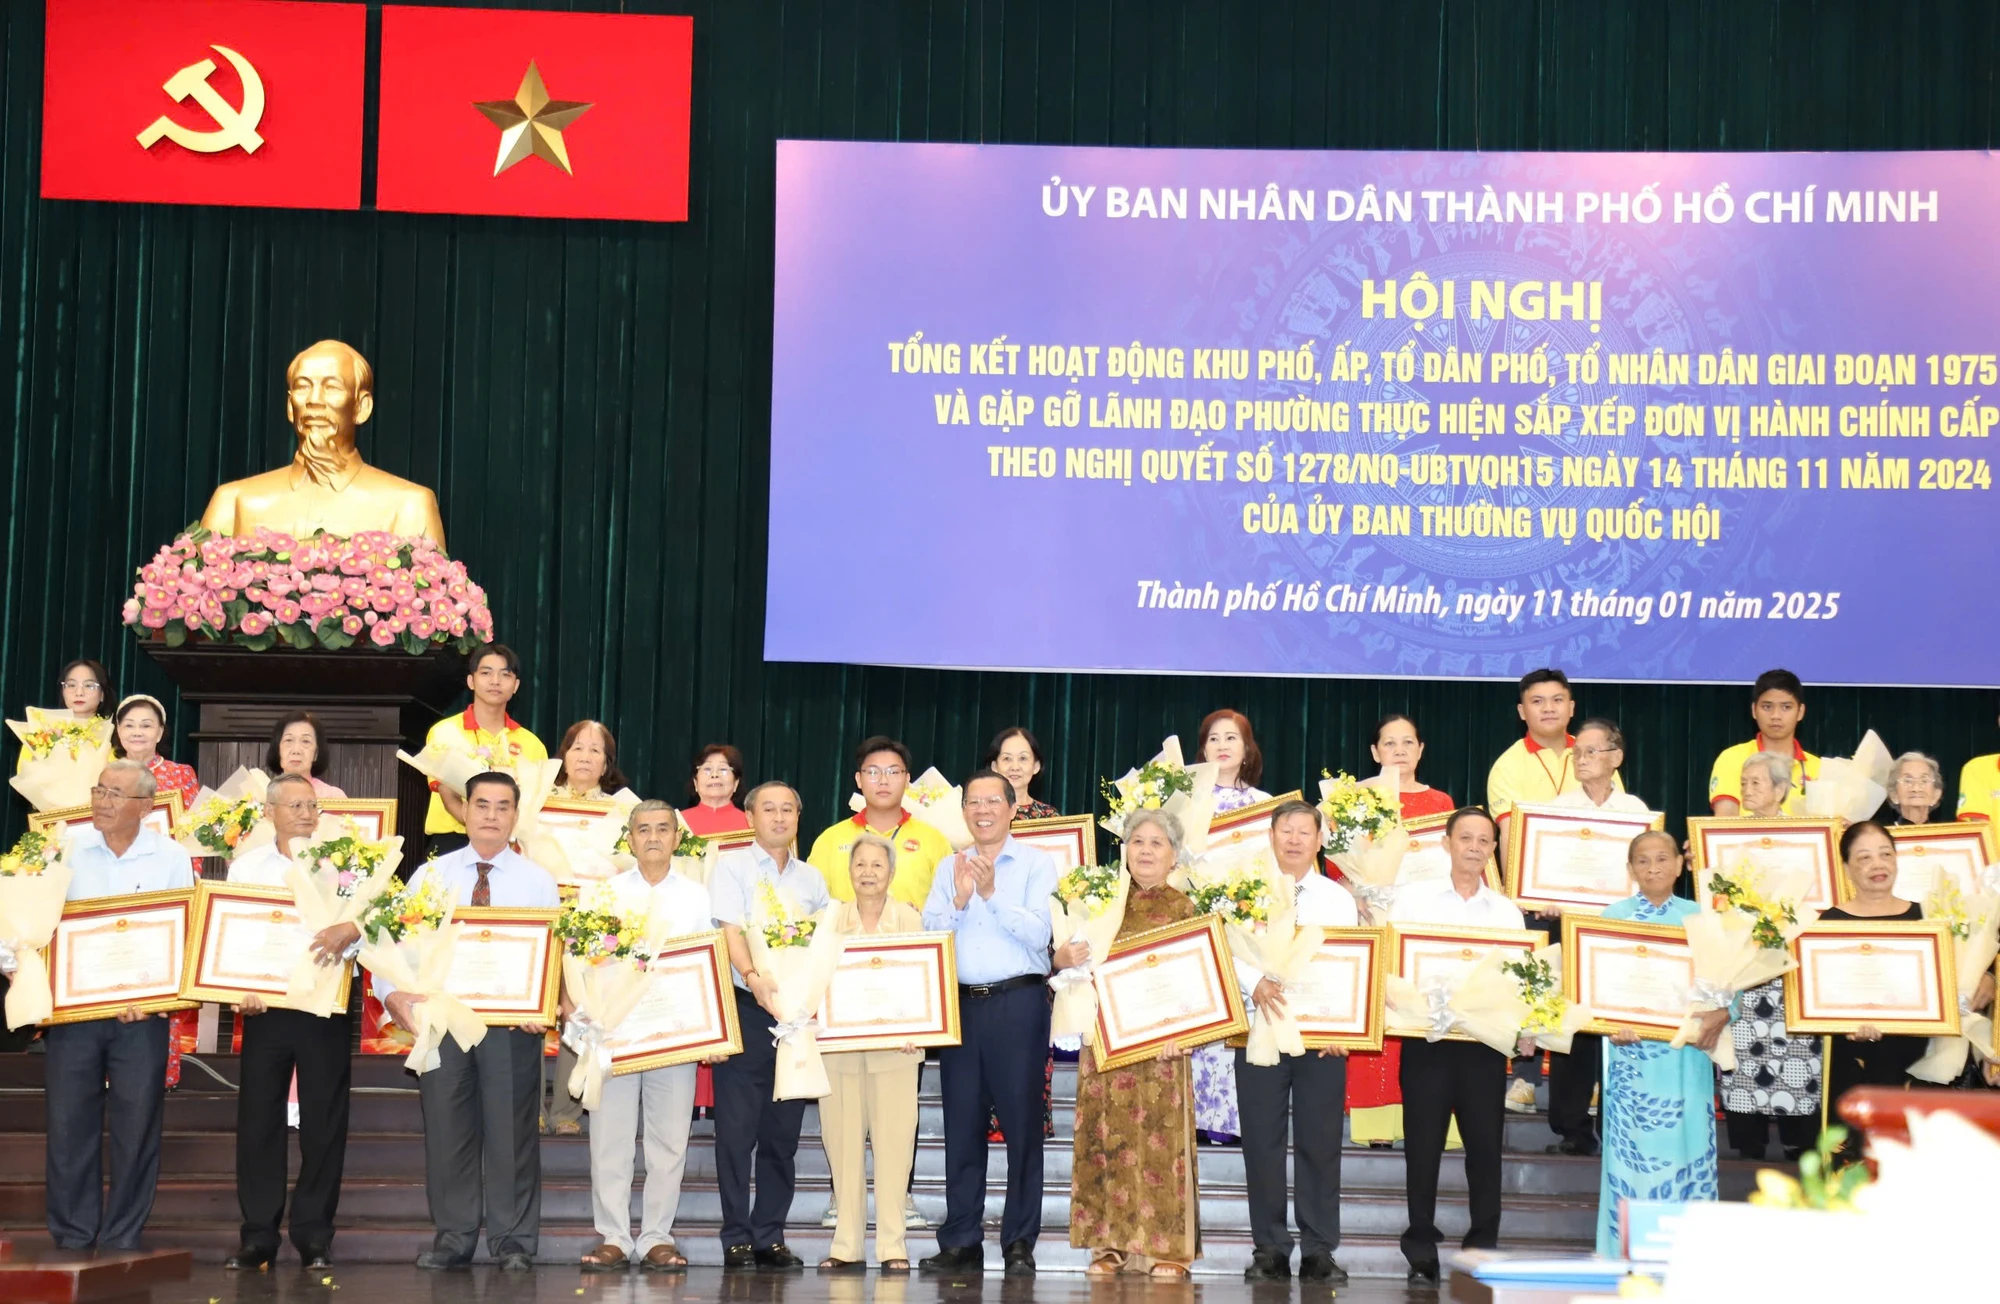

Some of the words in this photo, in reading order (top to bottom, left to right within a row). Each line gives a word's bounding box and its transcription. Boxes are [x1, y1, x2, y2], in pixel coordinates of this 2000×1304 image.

[1042, 175, 1096, 217] ỦY
[1106, 186, 1188, 219] BAN
[1199, 182, 1315, 221] NHÂN
[1327, 183, 1412, 222] DÂN
[1421, 184, 1564, 223] THÀNH
[1575, 181, 1662, 224] PHỐ
[1673, 181, 1735, 224] HỒ
[1744, 184, 1817, 224] CHÍ
[1826, 190, 1938, 223] MINH
[1362, 271, 1455, 332] HỘI
[1470, 280, 1602, 333] NGHỊ
[888, 331, 961, 373] TỔNG
[970, 334, 1021, 374] KẾT
[1029, 345, 1100, 383] HOẠT
[1107, 341, 1185, 384] ĐỘNG
[1193, 348, 1249, 380] KHU
[1258, 340, 1322, 384] PHỐ,
[1331, 344, 1372, 384] ẤP,
[1381, 340, 1416, 382] TỔ
[1423, 346, 1482, 383] DÂN
[1491, 343, 1556, 387] PHỐ,
[1565, 341, 1601, 384] TỔ
[1609, 347, 1690, 385] NHÂN
[1698, 348, 1758, 385] DÂN
[1767, 353, 1826, 385] GIAI
[1834, 353, 1916, 392] ĐOẠN
[1926, 354, 1998, 386] 1975
[935, 389, 970, 424] VÀ
[979, 390, 1035, 433] GẶP
[1043, 390, 1081, 427] GỠ
[1089, 392, 1162, 428] LÃNH
[1170, 399, 1227, 436] ĐẠO
[1235, 394, 1350, 432] PHƯỜNG
[1358, 400, 1430, 439] THỰC
[1439, 397, 1506, 441] HIỆN
[1514, 393, 1572, 435] SẮP
[1580, 395, 1636, 435] XẾP
[1644, 402, 1705, 437] ĐƠN
[1713, 405, 1741, 443] VỊ
[1750, 399, 1830, 437] HÀNH
[1839, 399, 1930, 437] CHÍNH
[1939, 395, 2000, 438] CẤP
[988, 446, 1056, 477] THEO
[1066, 448, 1132, 485] NGHỊ
[1141, 441, 1228, 483] QUYẾT
[1236, 441, 1275, 482] SỐ
[1283, 452, 1554, 489] 1278/NQ-UBTVQH15
[1562, 450, 1640, 487] NGÀY
[1649, 457, 1683, 488] 14
[1691, 451, 1787, 489] THÁNG
[1797, 458, 1828, 489] 11
[1841, 452, 1910, 489] NĂM
[1919, 458, 1992, 490] 2024
[1243, 493, 1299, 533] CỦA
[1308, 494, 1343, 534] ỦY
[1352, 504, 1411, 536] BAN
[1419, 499, 1532, 538] THƯỜNG
[1541, 507, 1577, 545] VỤ
[1586, 498, 1663, 542] QUỐC
[1672, 503, 1720, 547] HỘI
[1136, 580, 1220, 610] Thành
[1223, 579, 1282, 617] phố
[1282, 582, 1320, 613] Hồ
[1325, 580, 1369, 614] Chí
[1371, 584, 1449, 618] Minh,
[1455, 587, 1526, 623] ngày
[1532, 589, 1564, 617] 11
[1569, 587, 1653, 625] tháng
[1659, 590, 1693, 618] 01
[1699, 590, 1762, 619] năm
[1767, 591, 1840, 620] 2025
